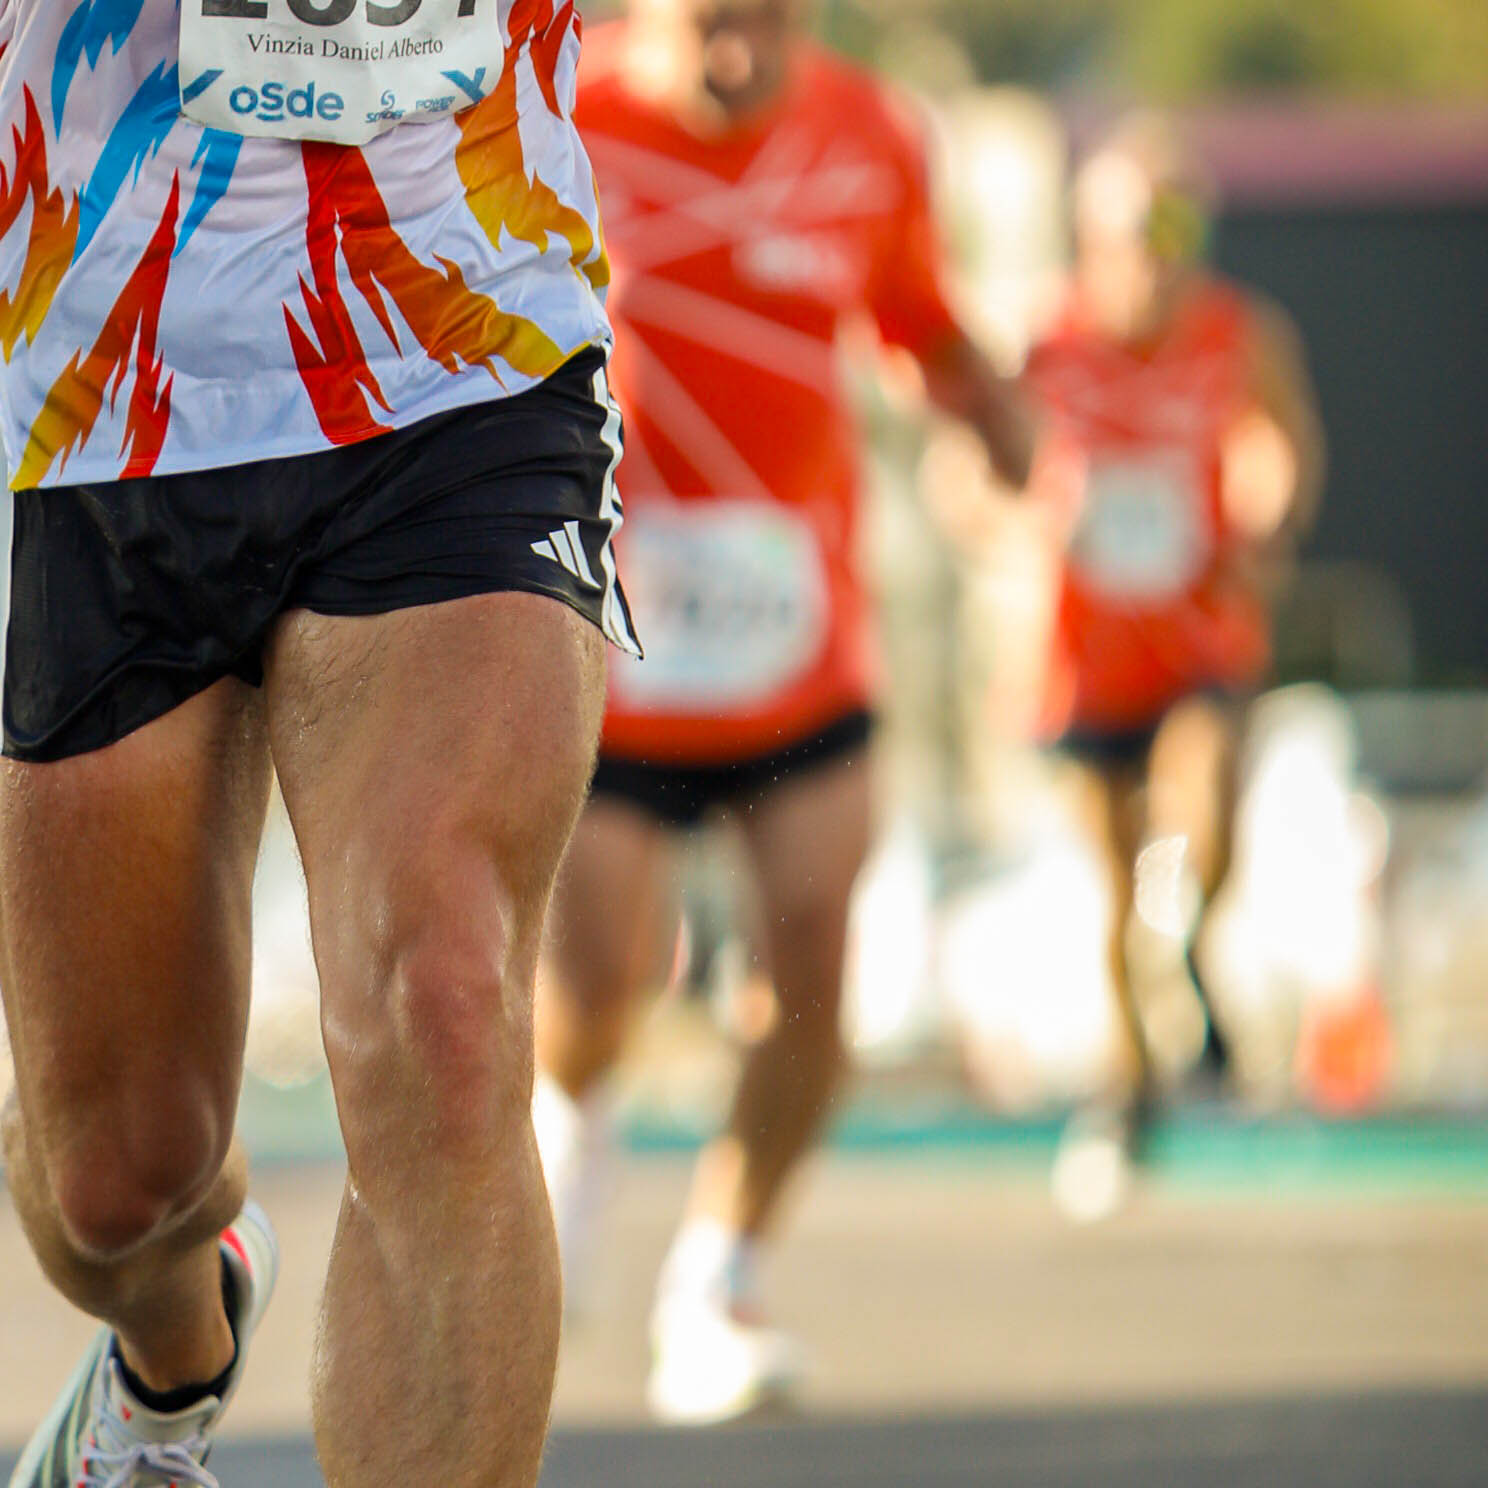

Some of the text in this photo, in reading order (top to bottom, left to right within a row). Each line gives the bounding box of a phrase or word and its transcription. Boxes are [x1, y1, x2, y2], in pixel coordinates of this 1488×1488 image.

[247, 33, 443, 61] Vinzia Daniel Alberto
[229, 80, 345, 122] osde
